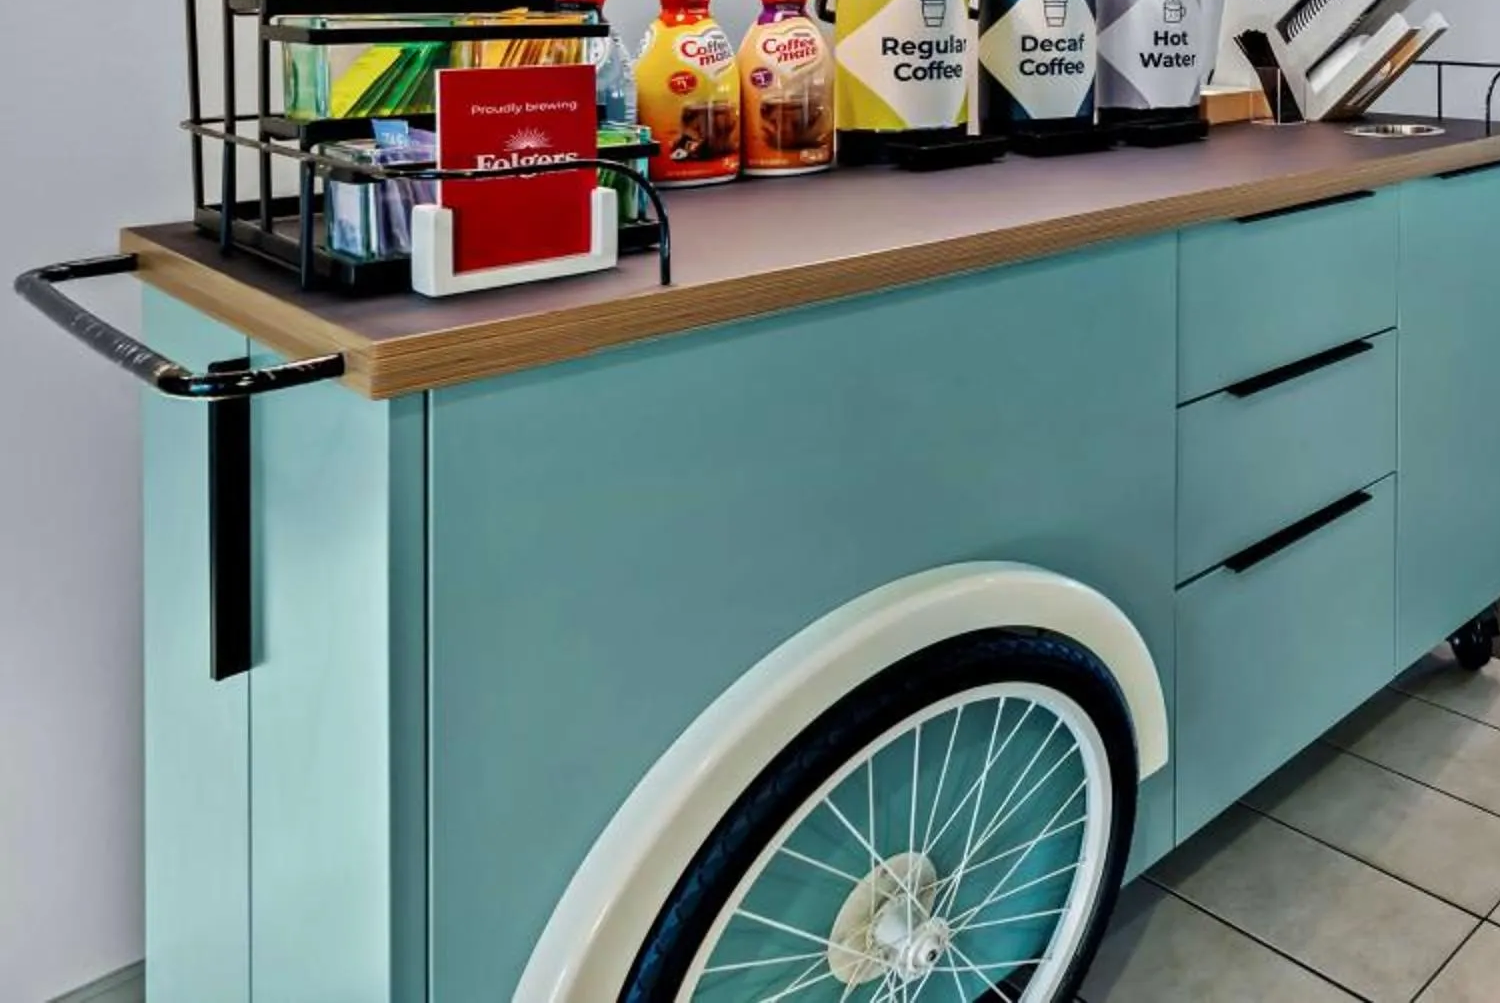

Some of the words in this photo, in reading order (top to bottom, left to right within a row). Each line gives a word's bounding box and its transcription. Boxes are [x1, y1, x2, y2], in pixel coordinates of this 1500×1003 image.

[1020, 35, 1085, 52] Decaf
[1153, 30, 1189, 46] Hot
[1019, 57, 1085, 76] Coffee
[1140, 52, 1196, 68] Water
[893, 60, 962, 81] Coffee
[471, 103, 522, 116] Proudly
[525, 101, 577, 112] brewing
